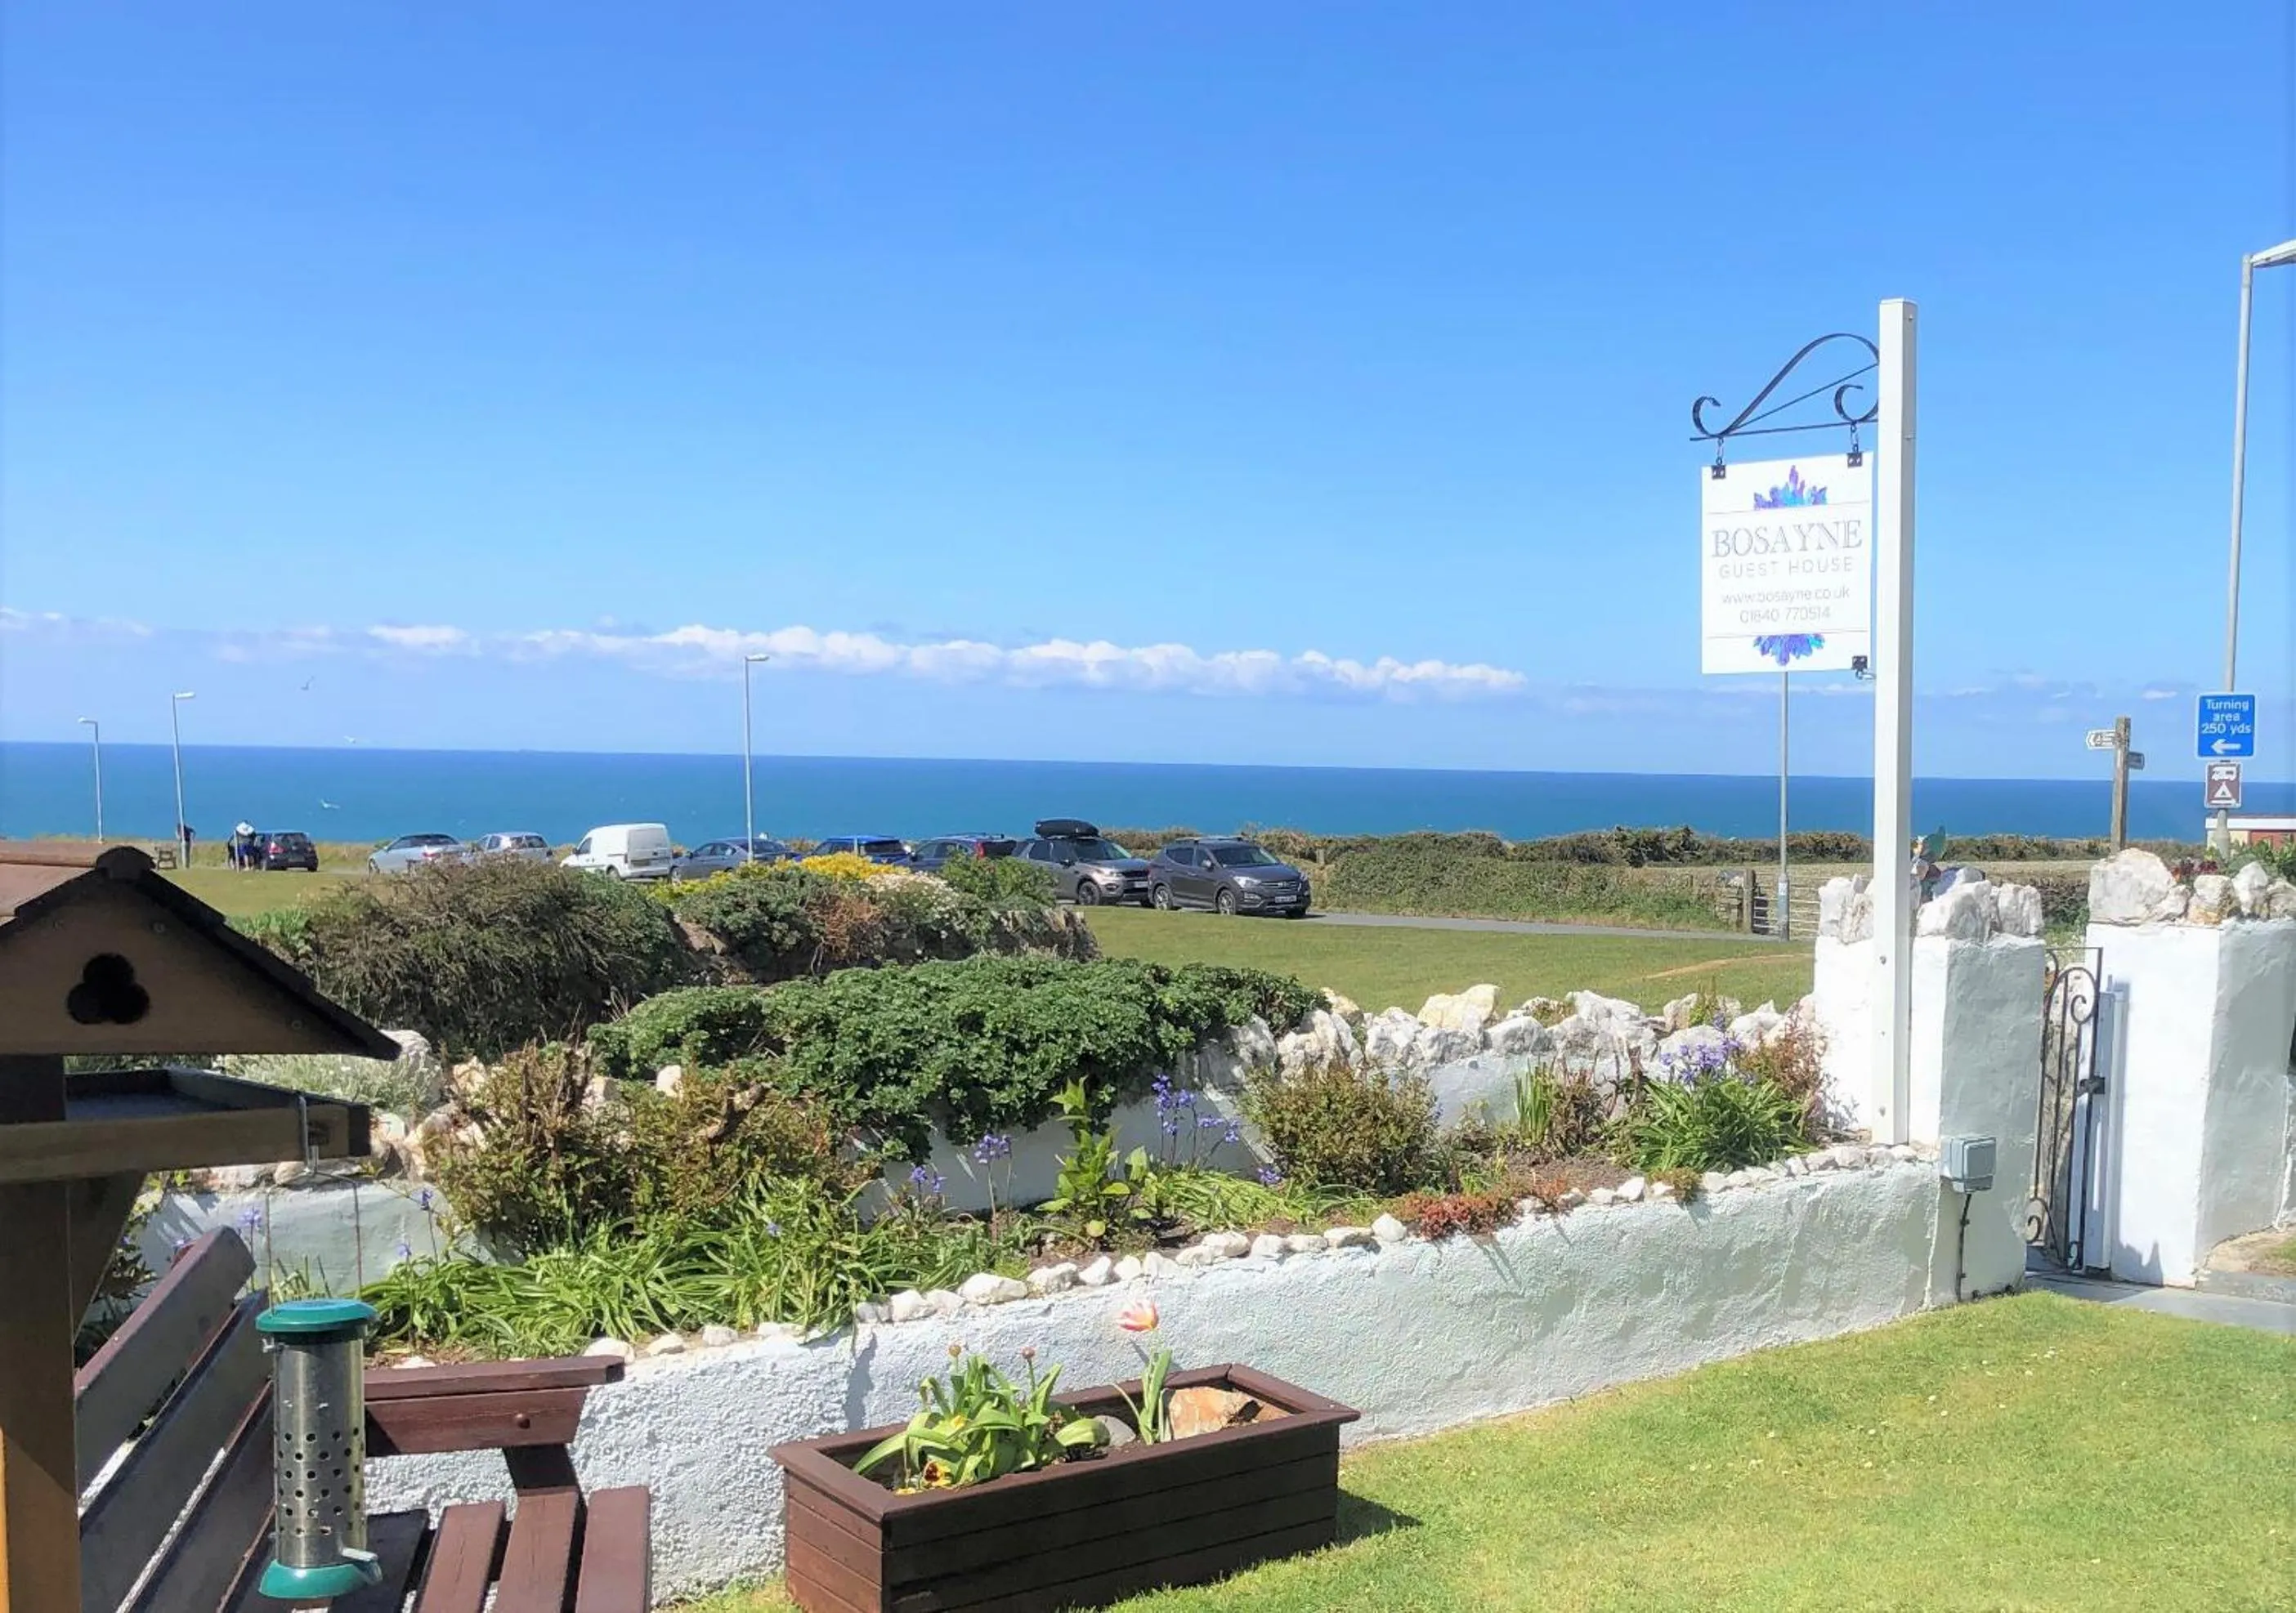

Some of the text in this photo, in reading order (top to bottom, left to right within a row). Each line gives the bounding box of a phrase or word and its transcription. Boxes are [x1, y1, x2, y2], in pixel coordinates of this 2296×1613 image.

[1712, 520, 1862, 557] BOSAYNE
[1719, 556, 1853, 579] GUEST HOUSE
[1722, 584, 1850, 605] www.bosayne.co.uk
[1740, 605, 1831, 623] 01840 770514
[2206, 699, 2249, 712] Turning
[2213, 713, 2240, 722] area
[2200, 722, 2252, 736] 250 yds
